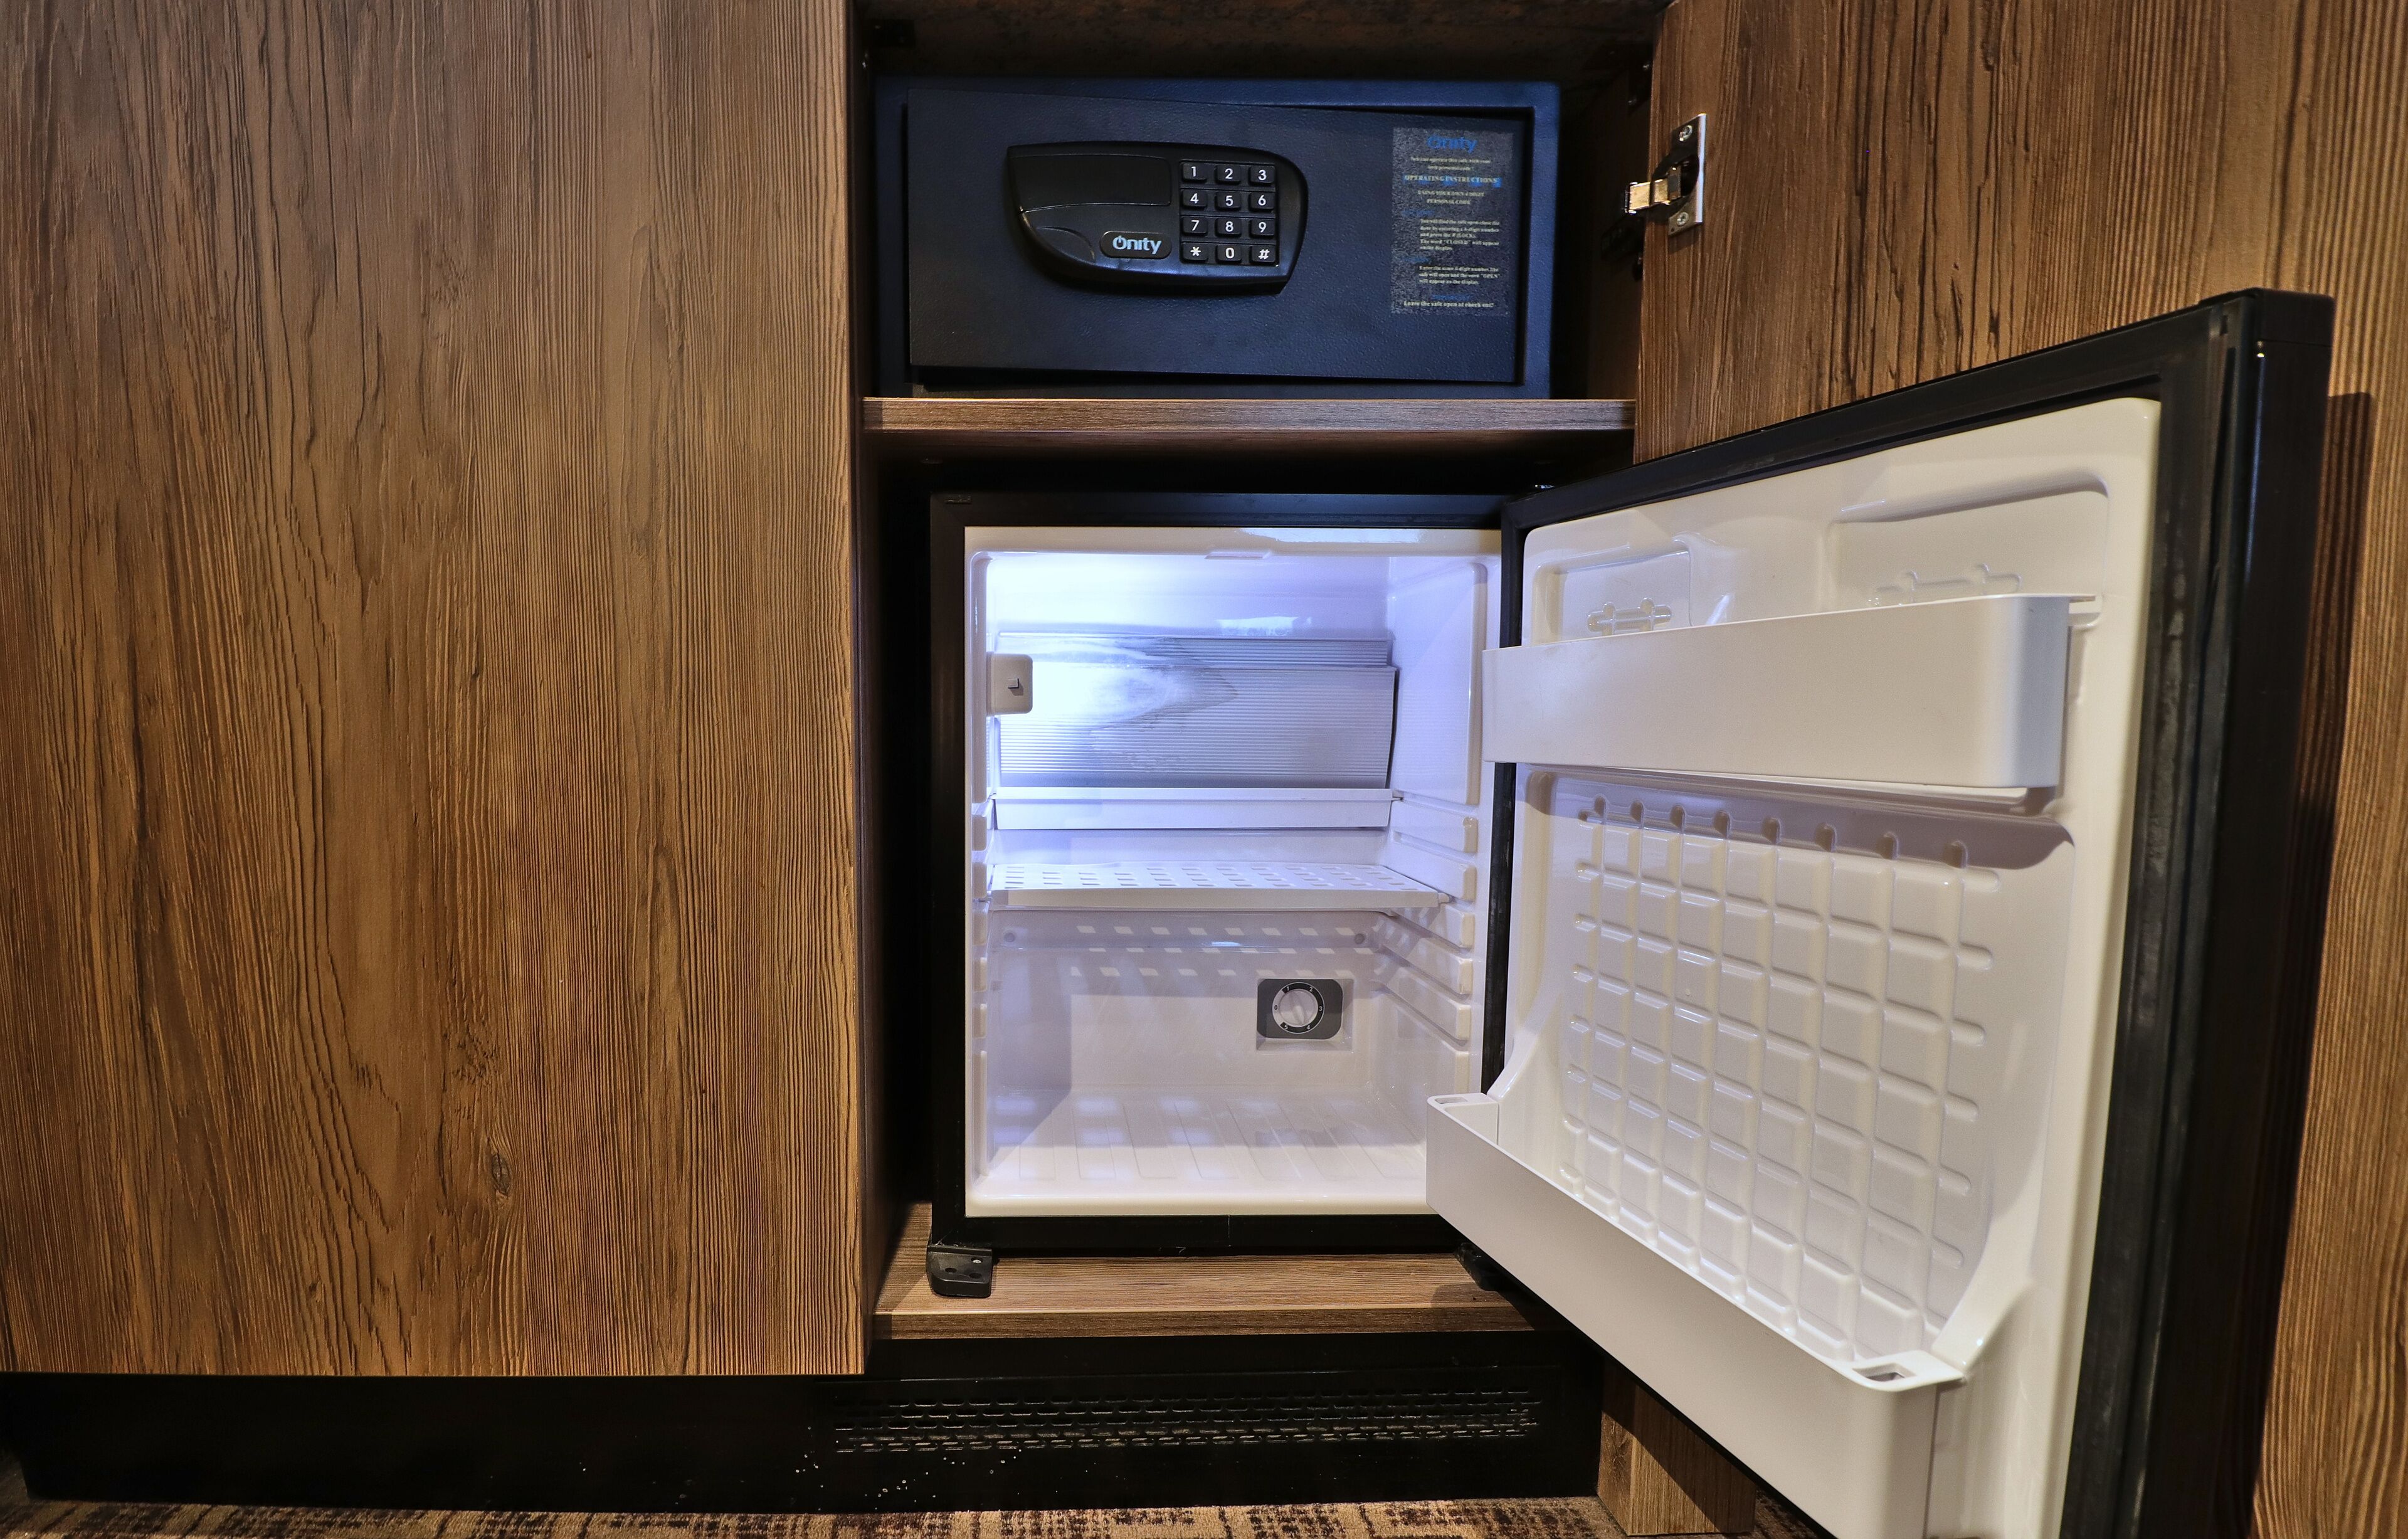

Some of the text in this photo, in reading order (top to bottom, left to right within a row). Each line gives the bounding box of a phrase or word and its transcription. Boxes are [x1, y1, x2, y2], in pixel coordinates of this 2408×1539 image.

[1191, 166, 1267, 181] 1 2 3
[1190, 193, 1267, 206] 4 5 6
[1191, 219, 1267, 233] 7 8 9
[1112, 235, 1161, 255] Onity
[1225, 247, 1235, 259] 0
